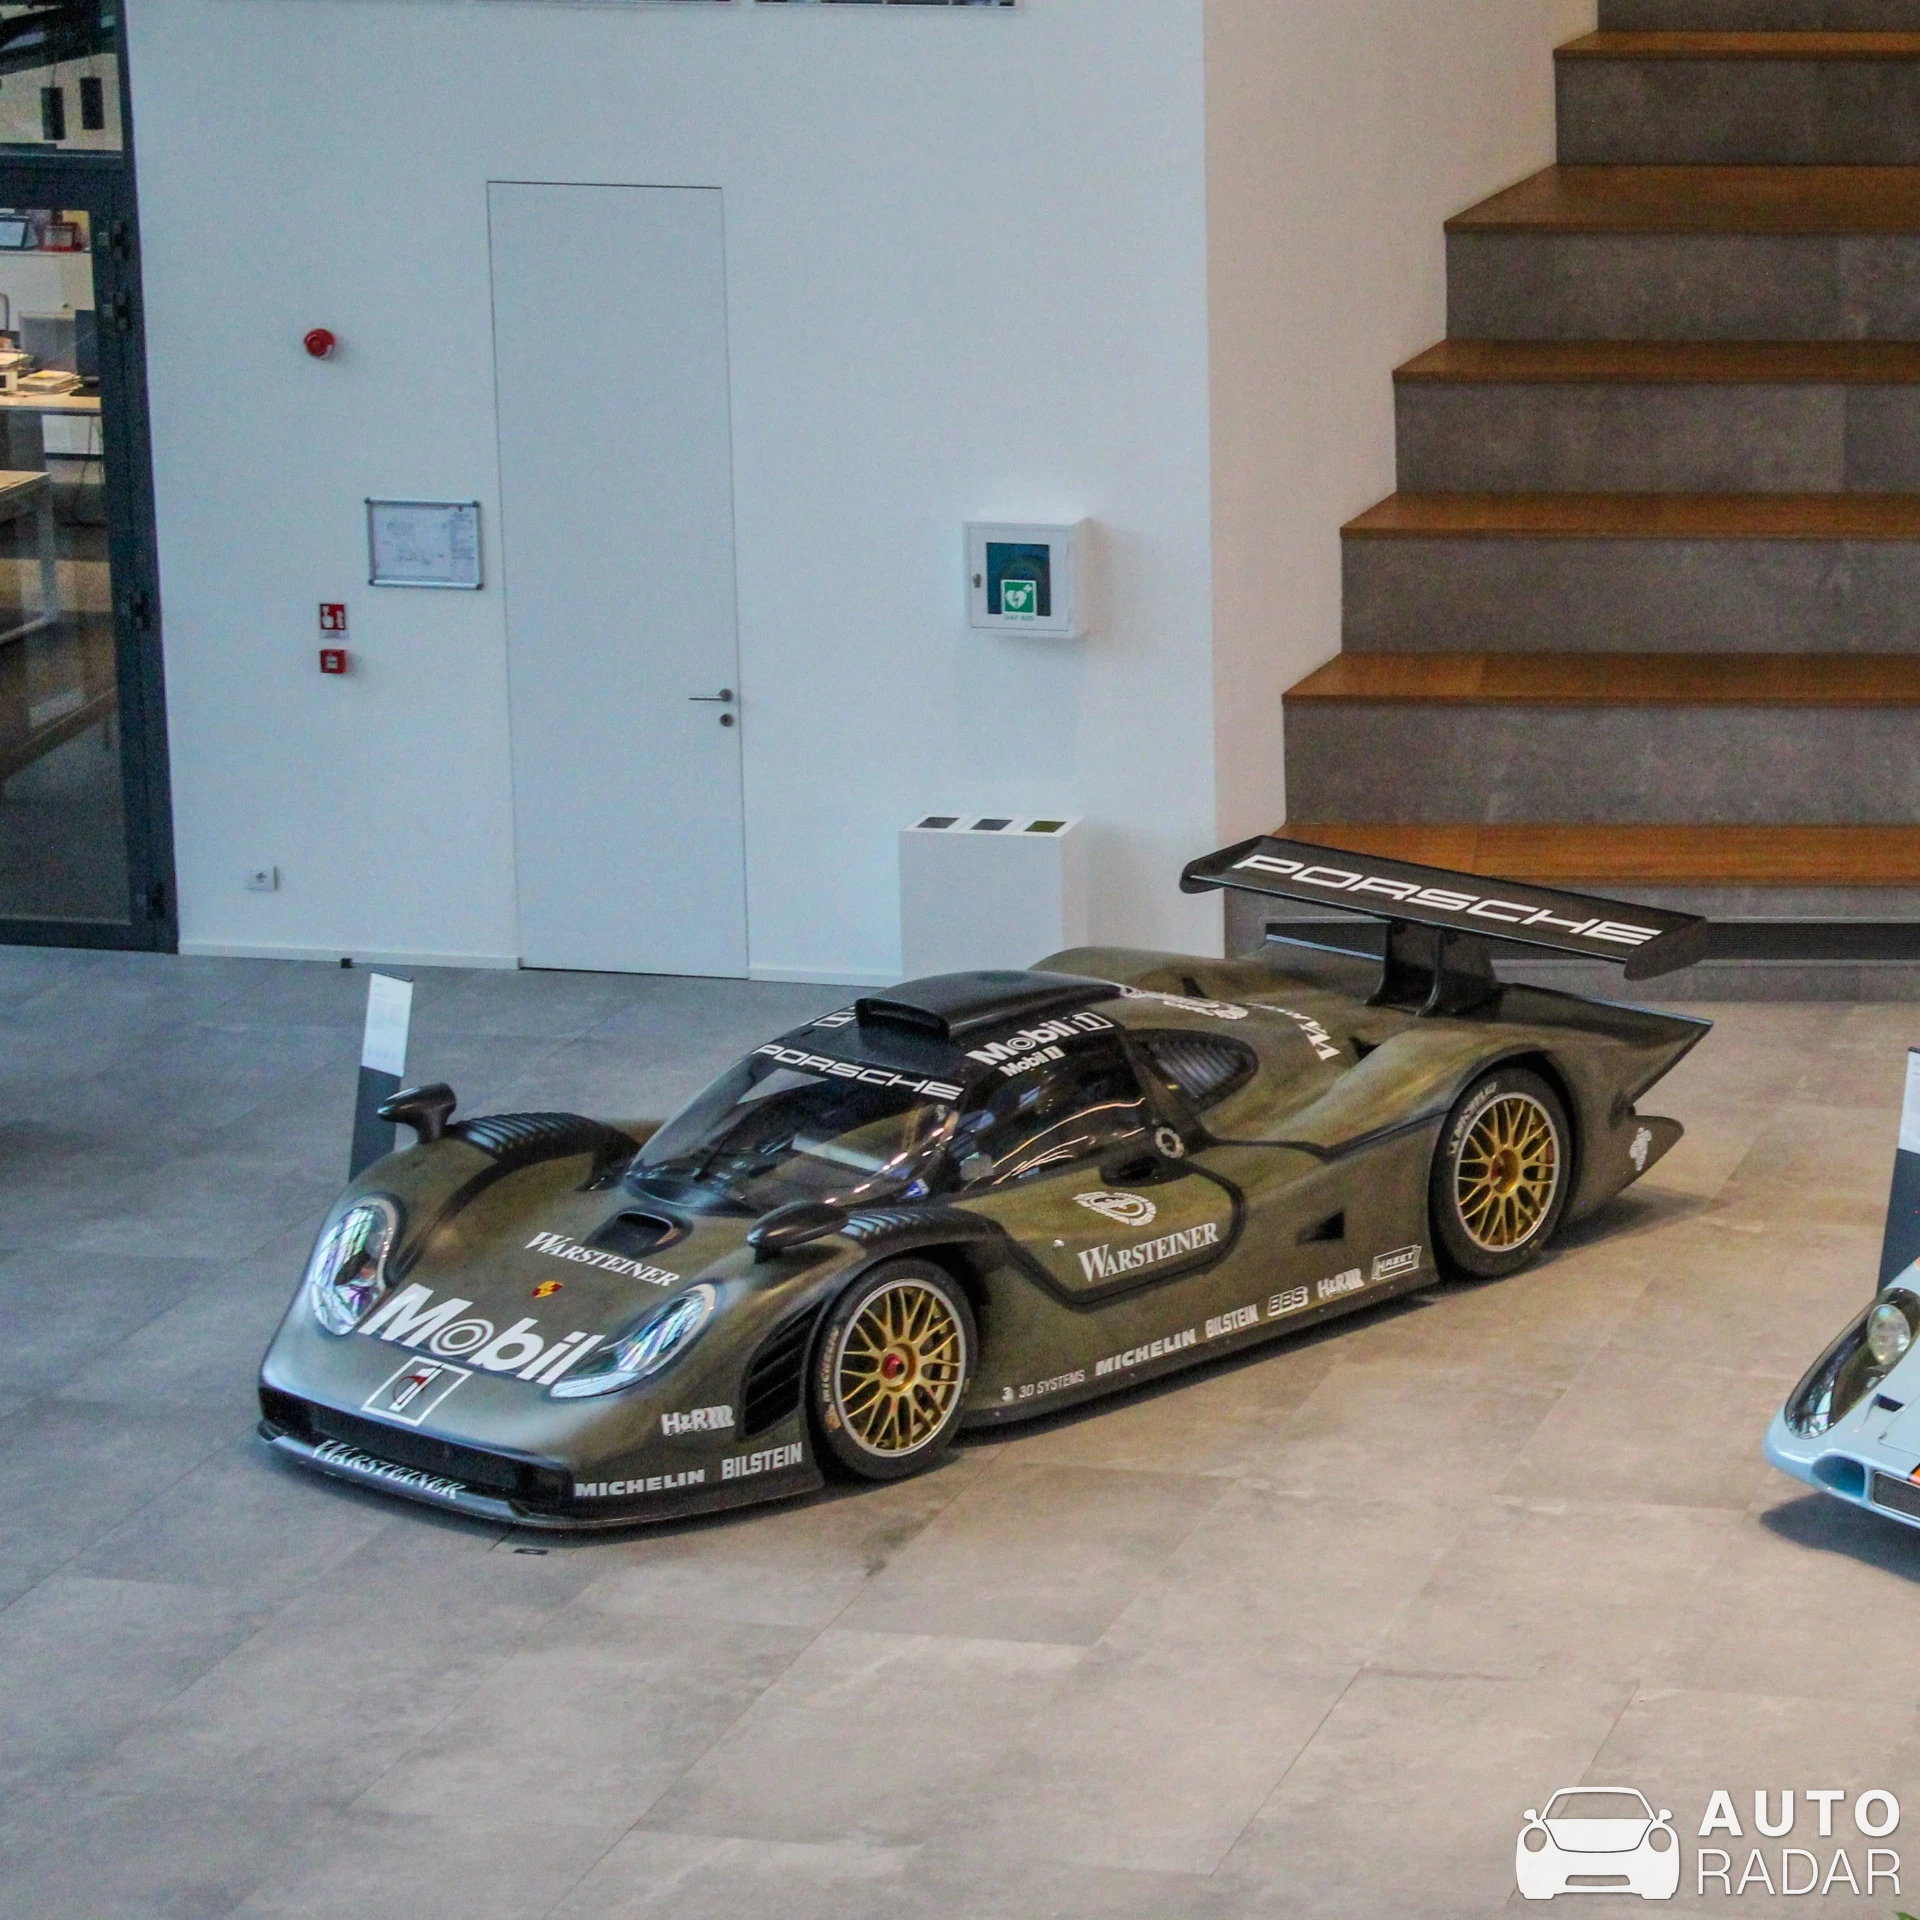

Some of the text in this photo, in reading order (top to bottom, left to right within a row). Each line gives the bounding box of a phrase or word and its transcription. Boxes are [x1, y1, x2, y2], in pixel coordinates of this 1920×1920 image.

[1231, 853, 1664, 946] PORSCHE
[964, 1019, 1080, 1066] Mobil
[998, 1051, 1050, 1077] Mobil
[751, 1044, 965, 1100] PORSCHE
[357, 1282, 606, 1386] Mobil
[1205, 1304, 1260, 1338] BILSTEIN
[1095, 1328, 1197, 1377] MICHELIN
[1018, 1383, 1035, 1398] 3D
[1036, 1369, 1085, 1395] SYSTEMS
[574, 1468, 705, 1497] MICHELIN
[721, 1441, 803, 1481] BILSTEIN
